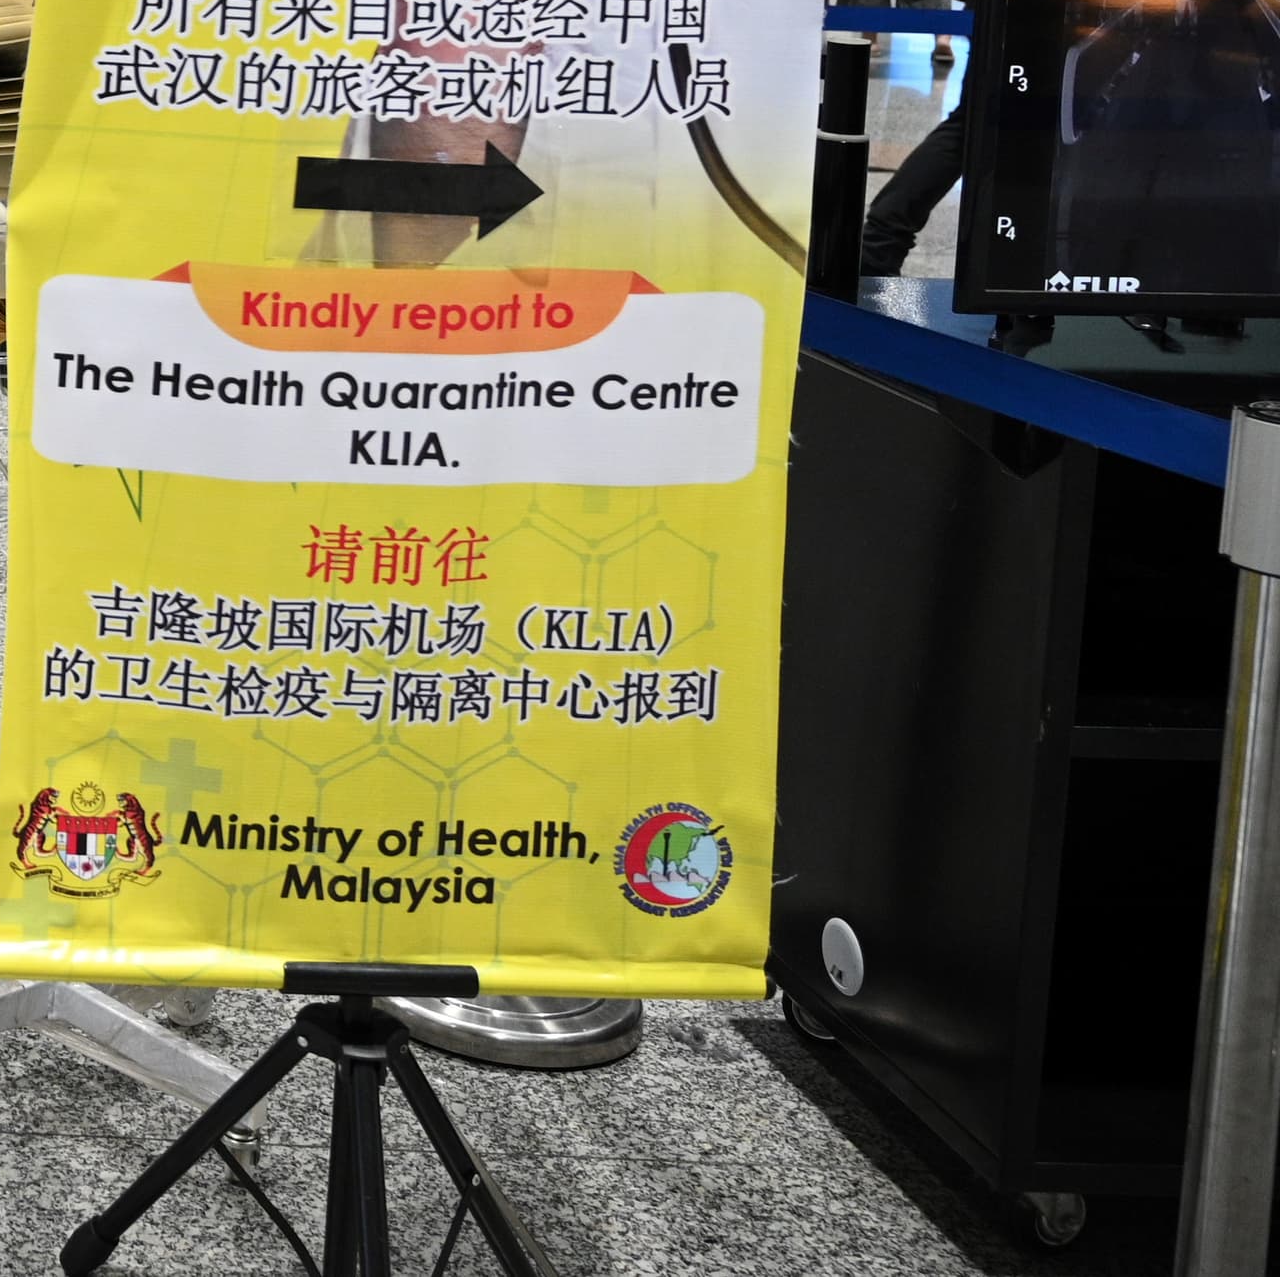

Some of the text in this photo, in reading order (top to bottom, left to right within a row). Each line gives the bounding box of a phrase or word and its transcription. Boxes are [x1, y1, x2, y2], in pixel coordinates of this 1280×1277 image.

[97, 43, 730, 119] 武汉的旅客或机组人员
[1072, 276, 1140, 293] FLIR
[242, 291, 575, 340] Kindly report to
[54, 352, 739, 411] The Health Quarantine Centre
[350, 430, 459, 468] KLIA.
[300, 524, 489, 587] 请前往
[45, 647, 718, 724] 的卫生检疫与隔离中心报到
[180, 810, 600, 865] Ministry of Health,
[620, 803, 663, 841] HEALTH
[667, 802, 713, 826] OFFICE
[280, 864, 495, 913] Malaysia
